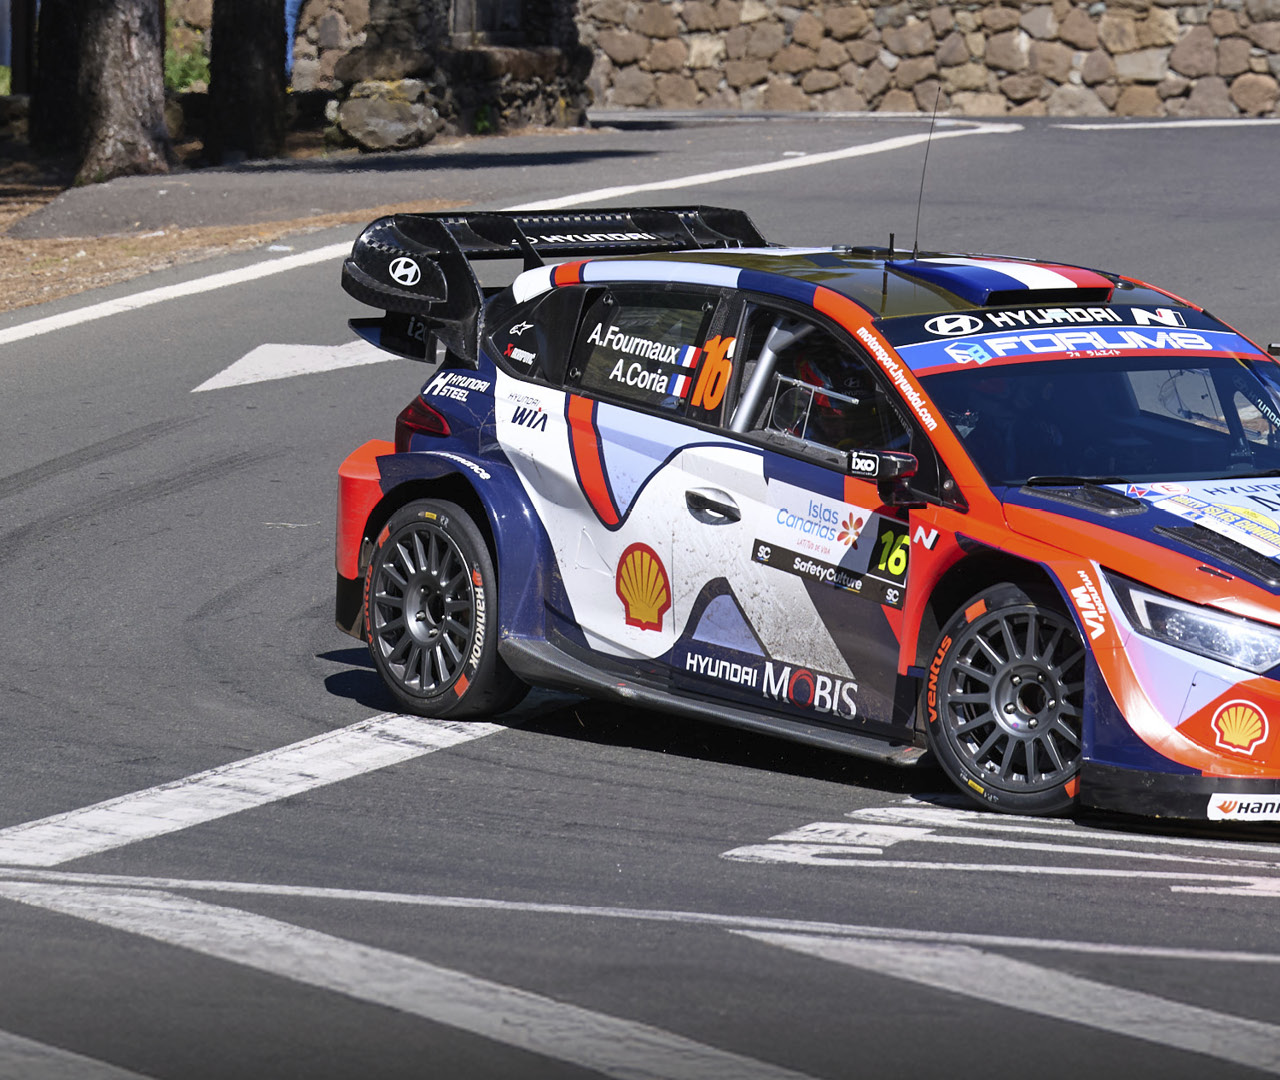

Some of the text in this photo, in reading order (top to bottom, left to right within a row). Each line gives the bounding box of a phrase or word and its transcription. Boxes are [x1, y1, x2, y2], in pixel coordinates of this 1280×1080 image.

[541, 232, 656, 243] HYUNDAI
[986, 307, 1123, 328] HYUNDAI
[587, 322, 680, 365] A.Fourmaux
[988, 331, 1213, 357] FORUM8
[448, 374, 491, 393] HYUNDAI
[609, 358, 669, 394] A.Coria
[691, 334, 736, 411] 16
[856, 326, 938, 432] motorsport.hyundai.com
[439, 385, 469, 403] STEEL
[508, 393, 541, 407] HYUNDAI
[851, 451, 876, 472] ixo
[777, 508, 837, 542] Canarias
[808, 499, 839, 525] Islas
[913, 525, 941, 551] N
[757, 545, 771, 559] SC
[878, 530, 910, 576] 16
[793, 557, 863, 591] SafetyCulture
[886, 587, 900, 602] SC
[686, 652, 859, 720] HYUNDAI MOBIS
